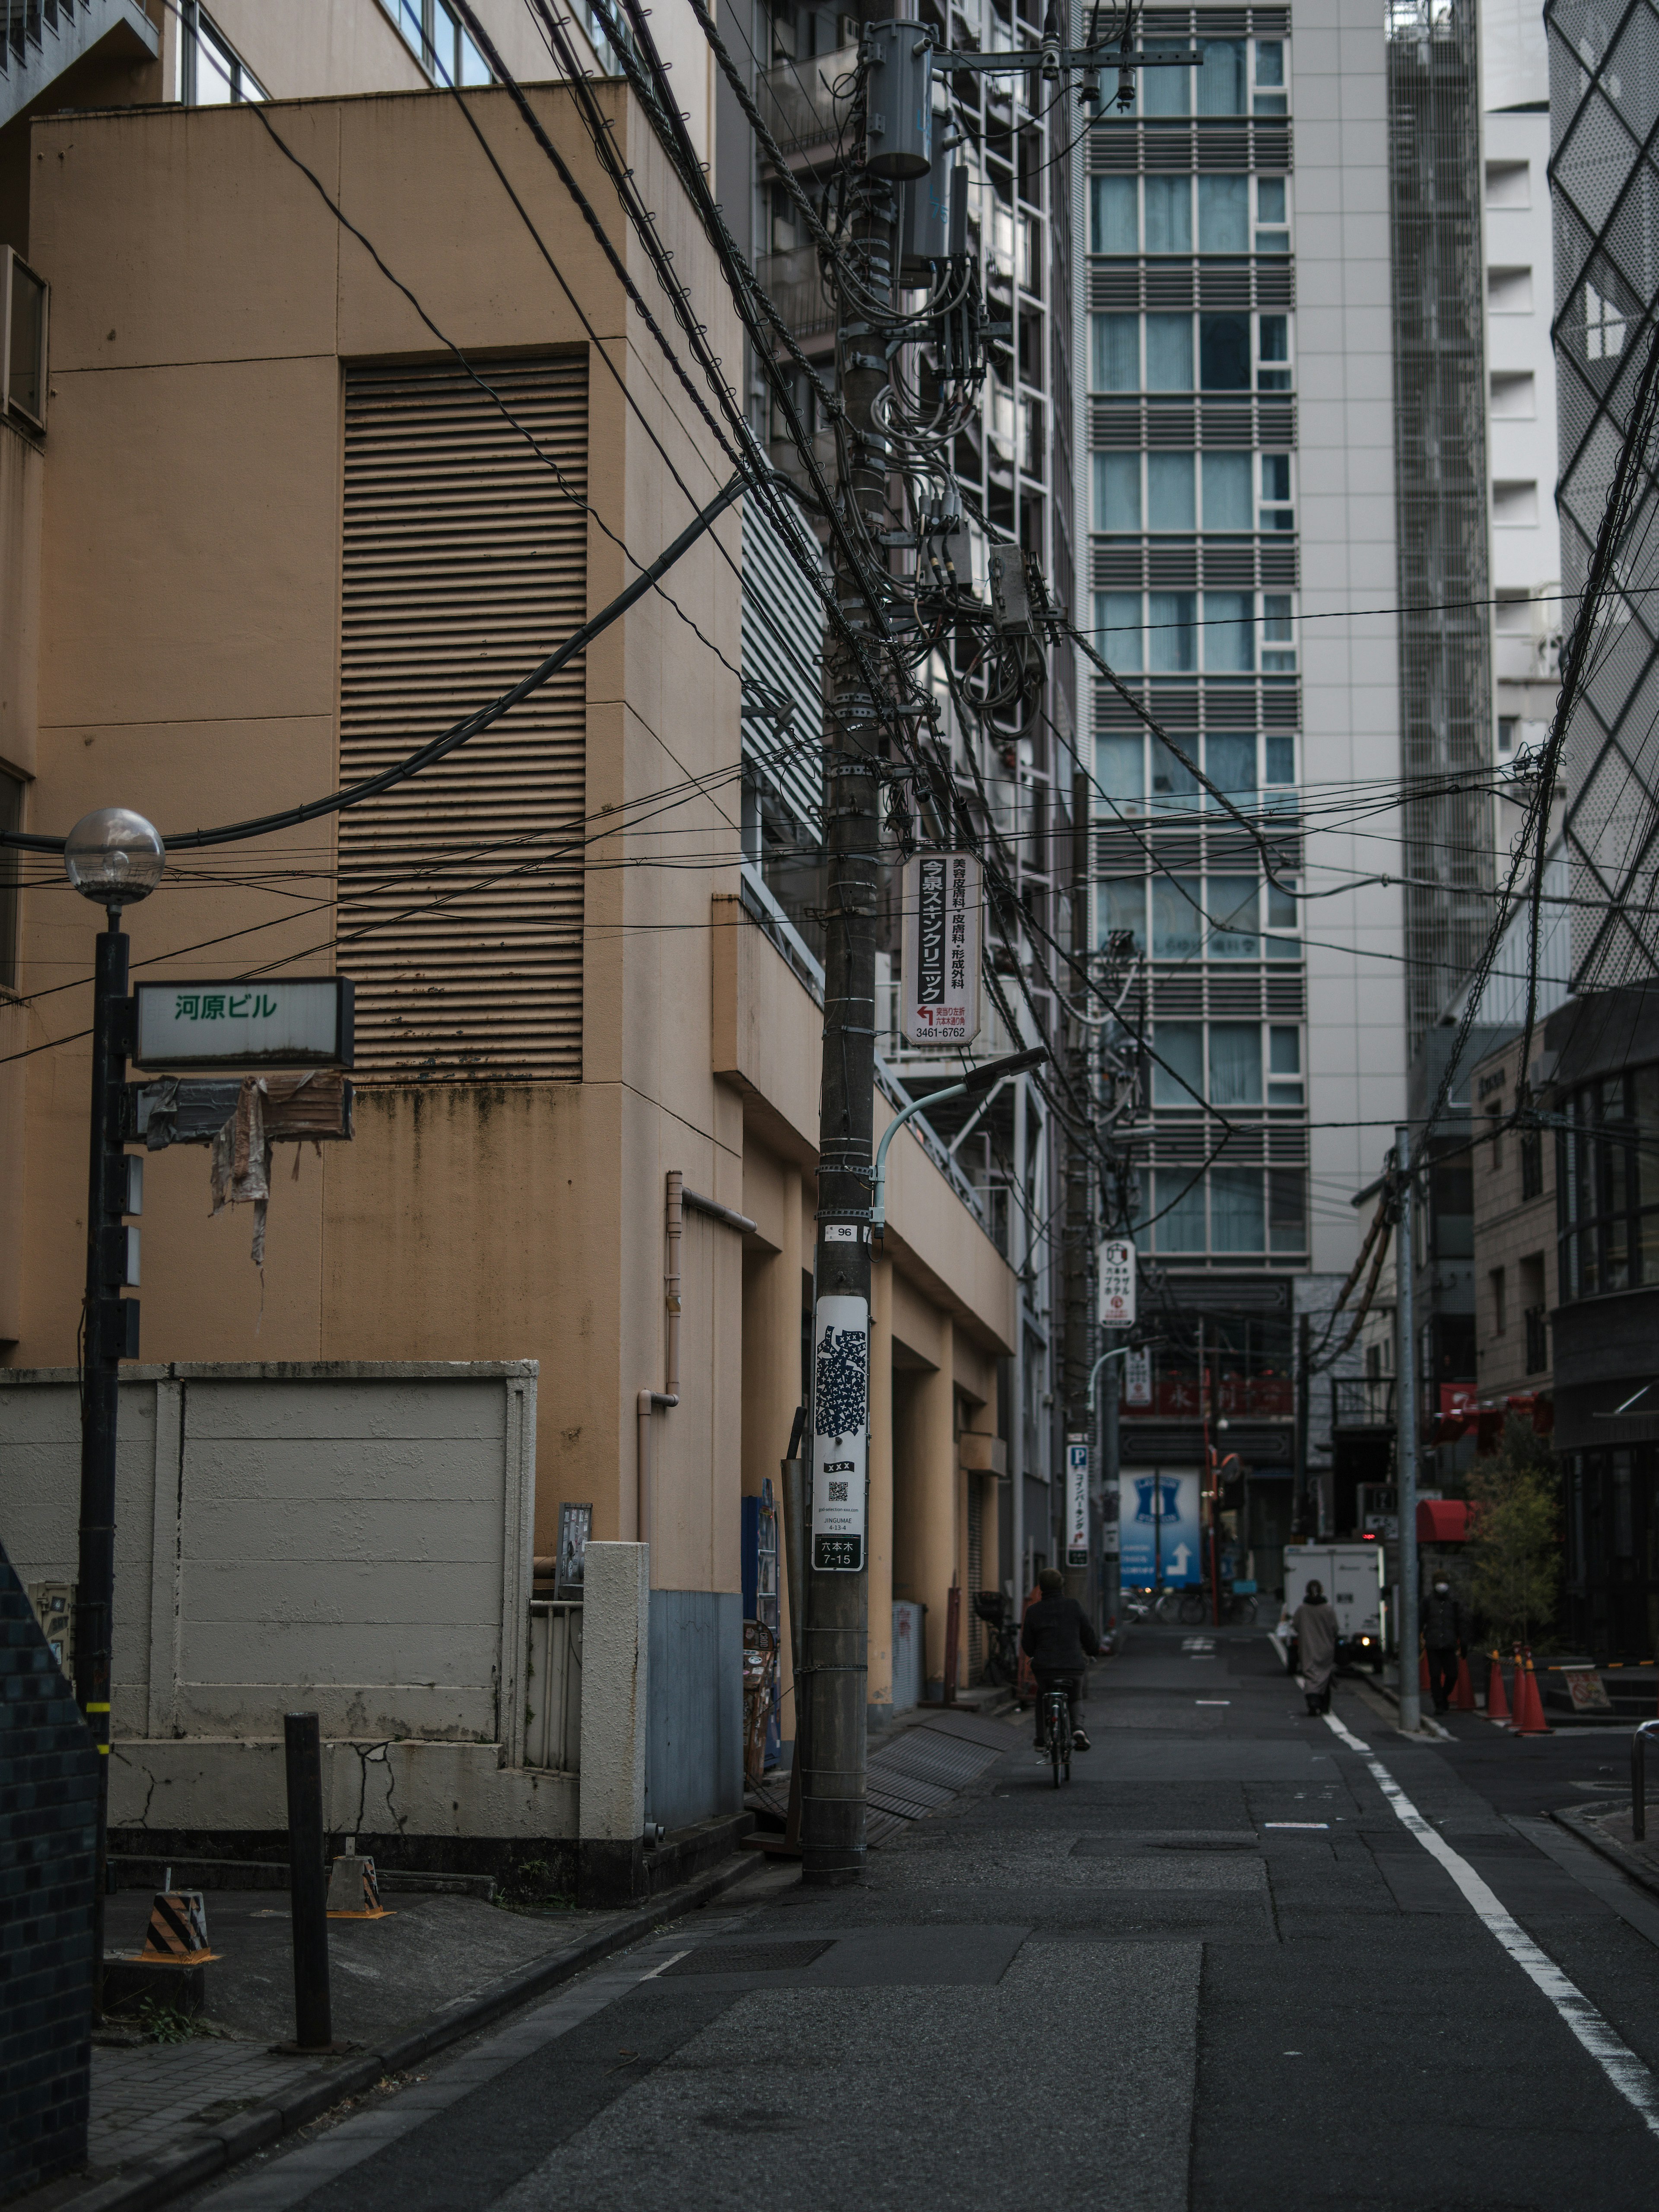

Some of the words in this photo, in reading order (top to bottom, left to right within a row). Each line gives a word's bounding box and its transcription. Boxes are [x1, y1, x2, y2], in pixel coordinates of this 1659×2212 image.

[922, 861, 944, 1001] 今泉スキンクリニック
[175, 994, 277, 1020] 河原ビル
[936, 1007, 965, 1016] 突当り左折
[916, 1028, 965, 1037] 3461-6762
[822, 1541, 853, 1551] 六本木
[824, 1554, 850, 1564] 7-15
